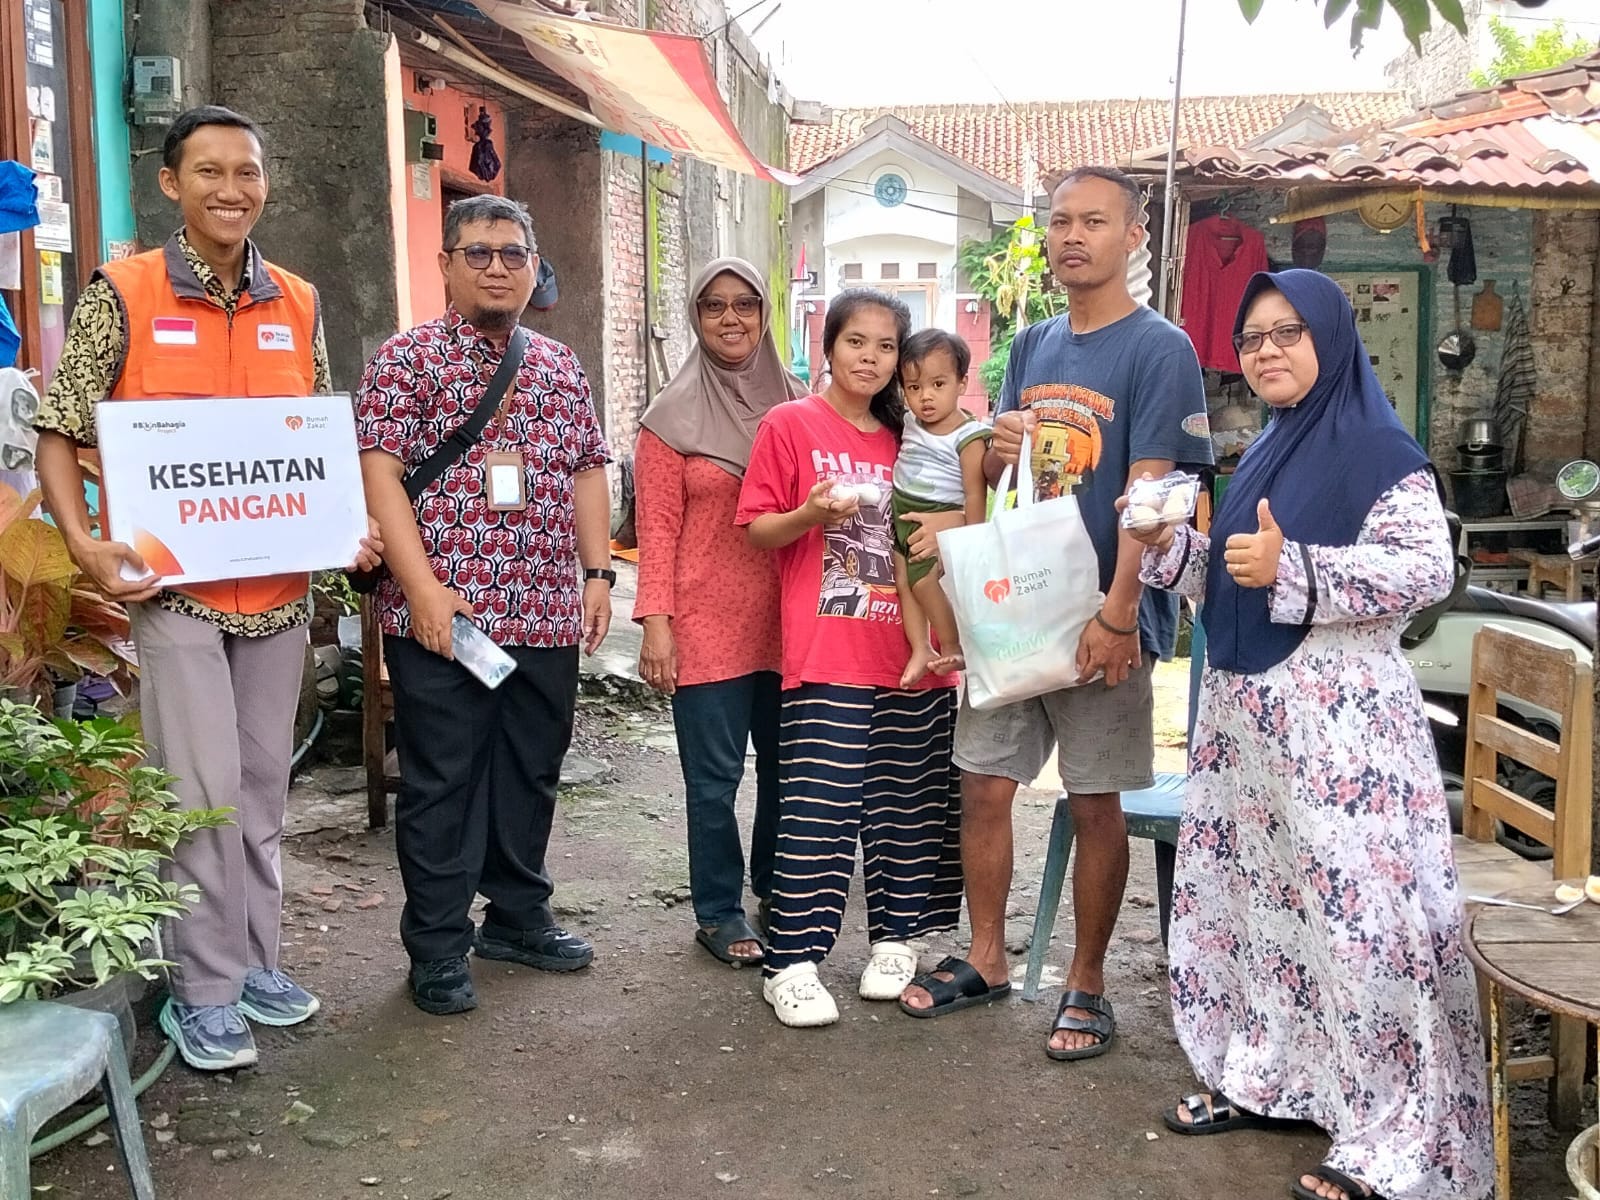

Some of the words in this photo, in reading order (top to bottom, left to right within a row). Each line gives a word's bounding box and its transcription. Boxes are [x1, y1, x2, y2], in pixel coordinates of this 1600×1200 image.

[148, 457, 326, 490] KESEHATAN
[178, 492, 307, 525] PANGAN
[1013, 567, 1052, 585] Rumah
[1016, 579, 1049, 596] Zakat
[870, 600, 898, 615] 0271
